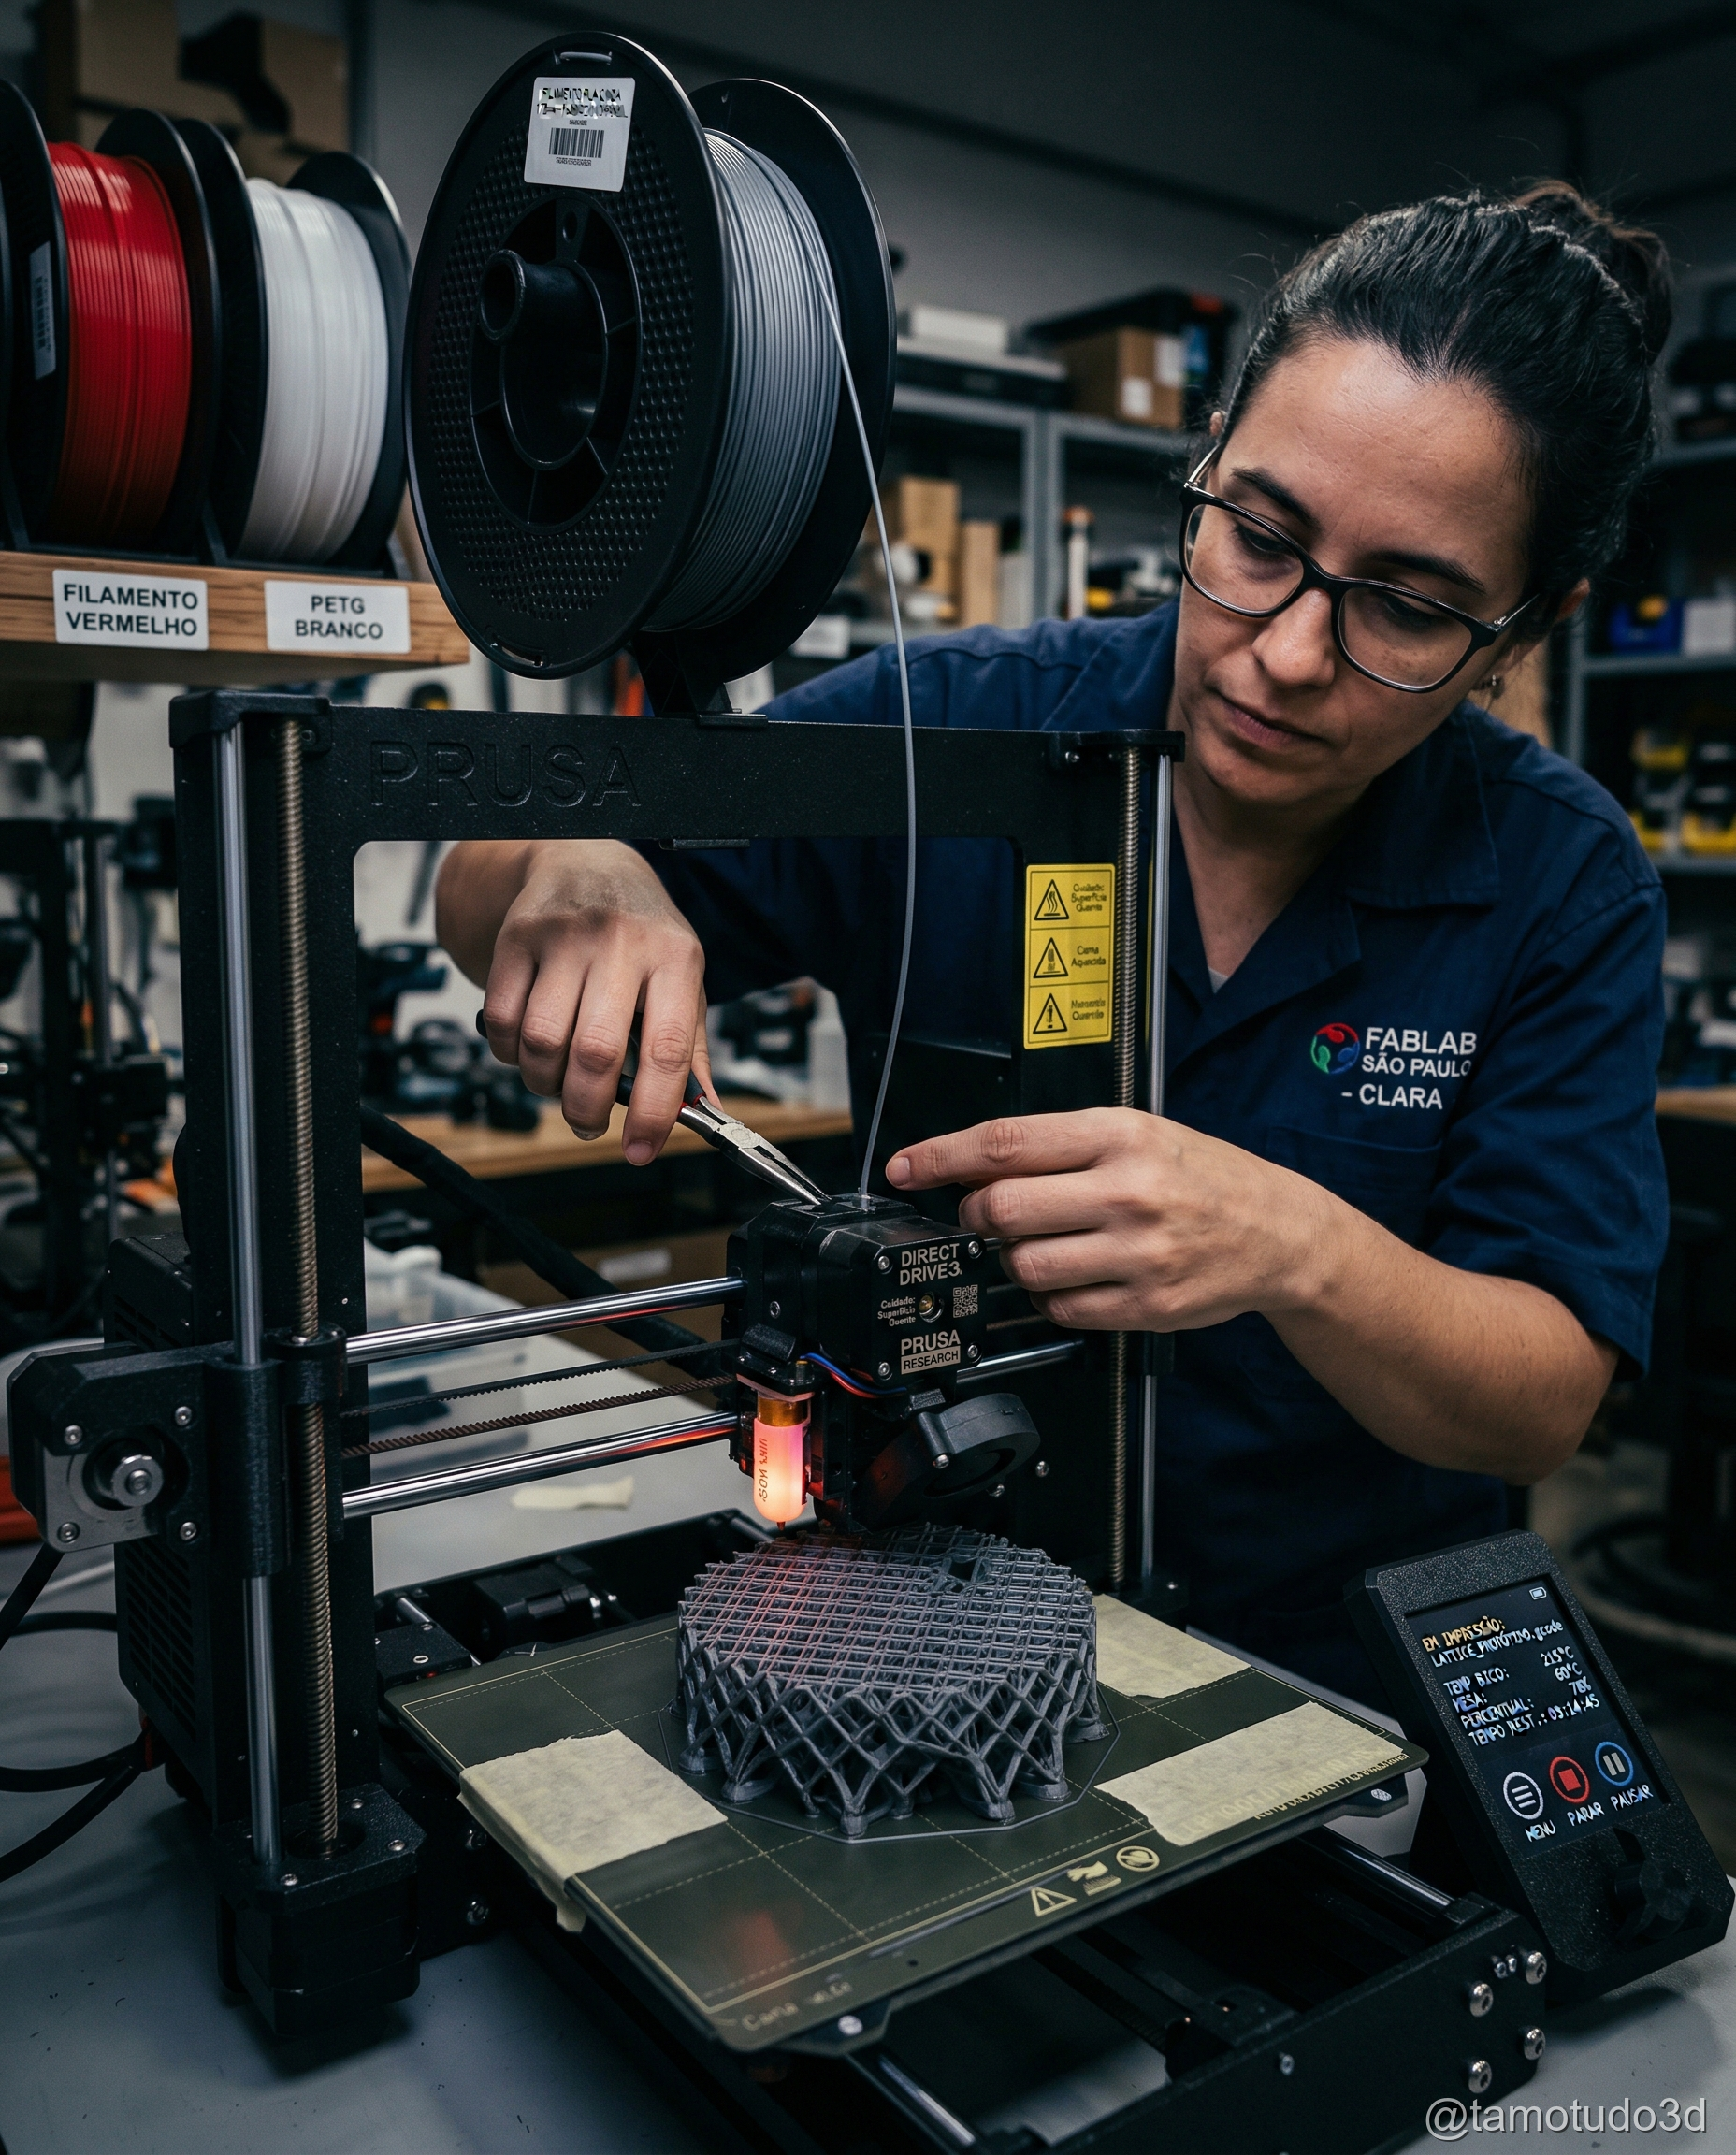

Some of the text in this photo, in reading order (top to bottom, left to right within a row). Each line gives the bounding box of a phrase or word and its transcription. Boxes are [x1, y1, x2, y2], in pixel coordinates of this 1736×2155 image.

[63, 583, 198, 610] FILAMENTO
[311, 595, 366, 615] PETG
[65, 611, 198, 637] VERMELHO
[295, 620, 383, 641] BRANCO
[370, 740, 642, 807] PRUSA
[1366, 1026, 1477, 1056] FABLAB
[1361, 1051, 1472, 1078] SÃO PAULO
[1359, 1083, 1443, 1110] CLARA
[901, 1243, 960, 1267] DIRECT
[901, 1329, 961, 1356] PRUSA
[904, 1350, 959, 1370] RESEARCH
[1610, 1784, 1654, 1811] PAUSAR
[1567, 1801, 1605, 1827] PARAR
